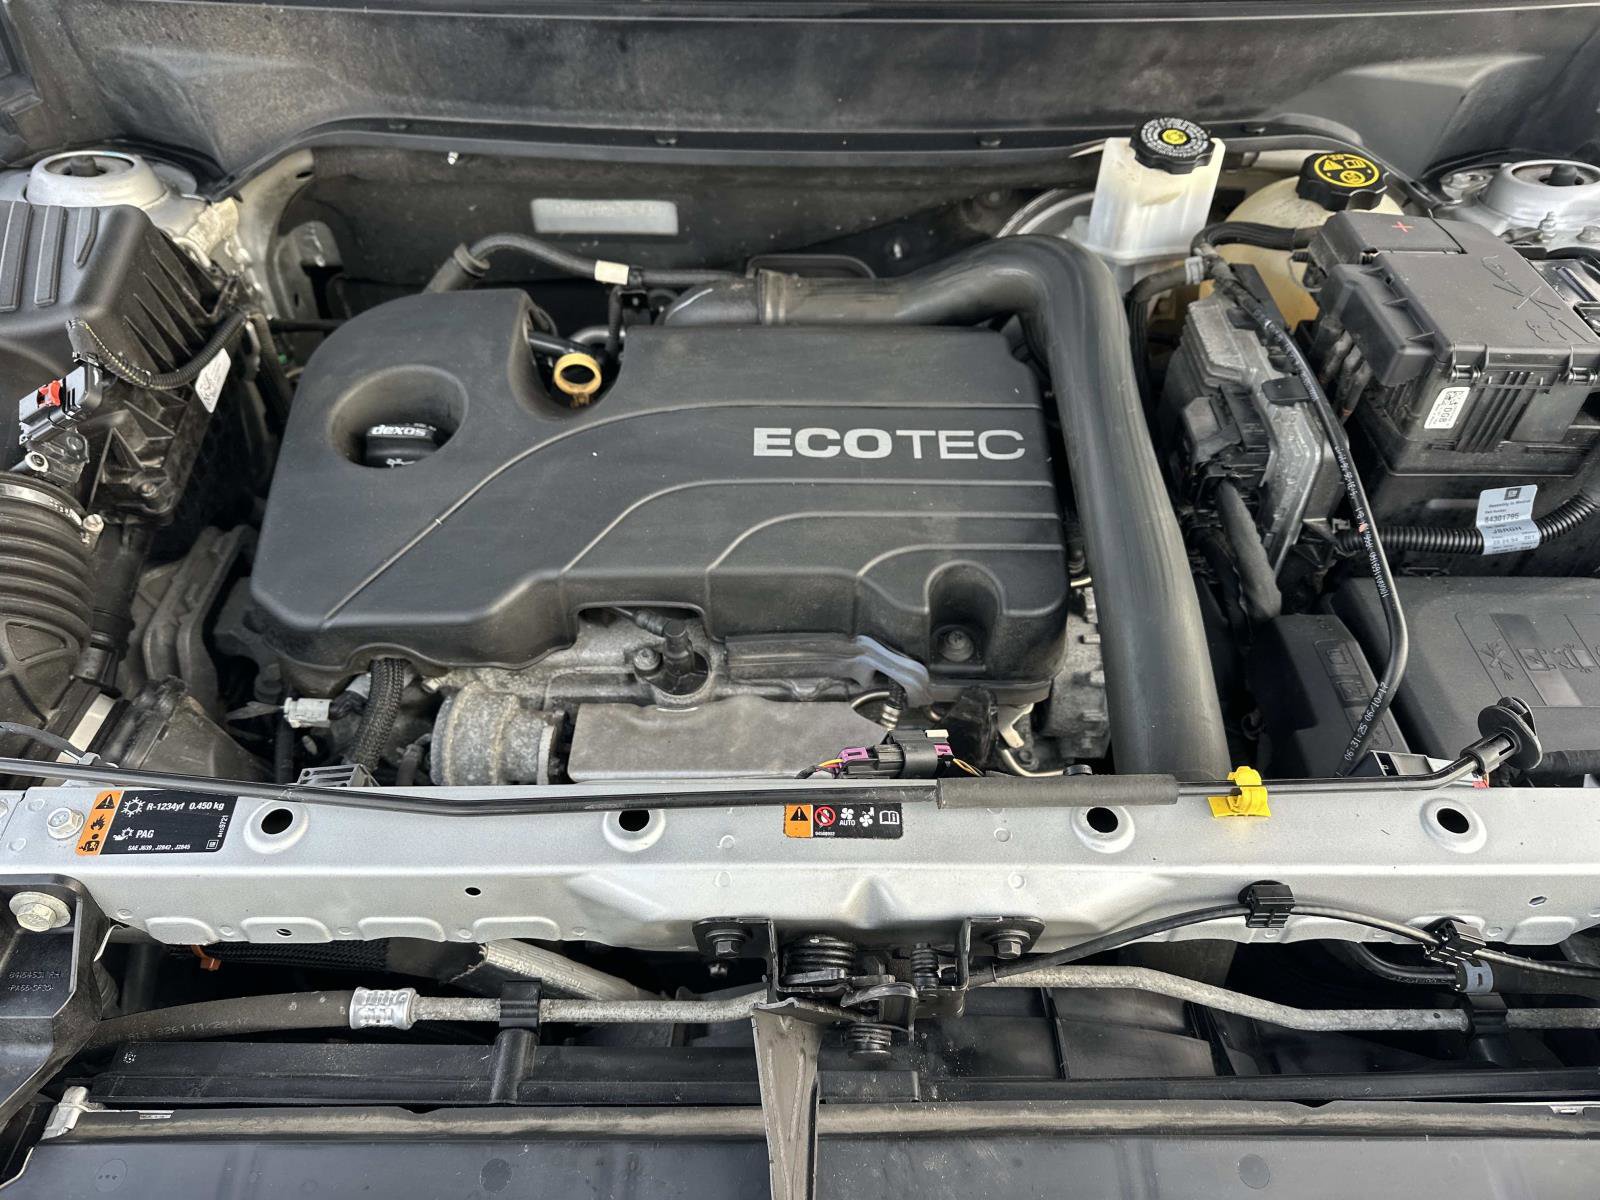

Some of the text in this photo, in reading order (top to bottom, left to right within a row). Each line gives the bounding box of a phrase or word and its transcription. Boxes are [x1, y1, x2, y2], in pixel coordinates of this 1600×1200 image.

[371, 424, 427, 437] dexos
[753, 427, 1026, 460] ECOTEC
[1344, 681, 1389, 761] 06:31:25 06/10/17
[146, 801, 225, 811] R-1234yf 0.450 kg
[135, 830, 155, 839] PAG
